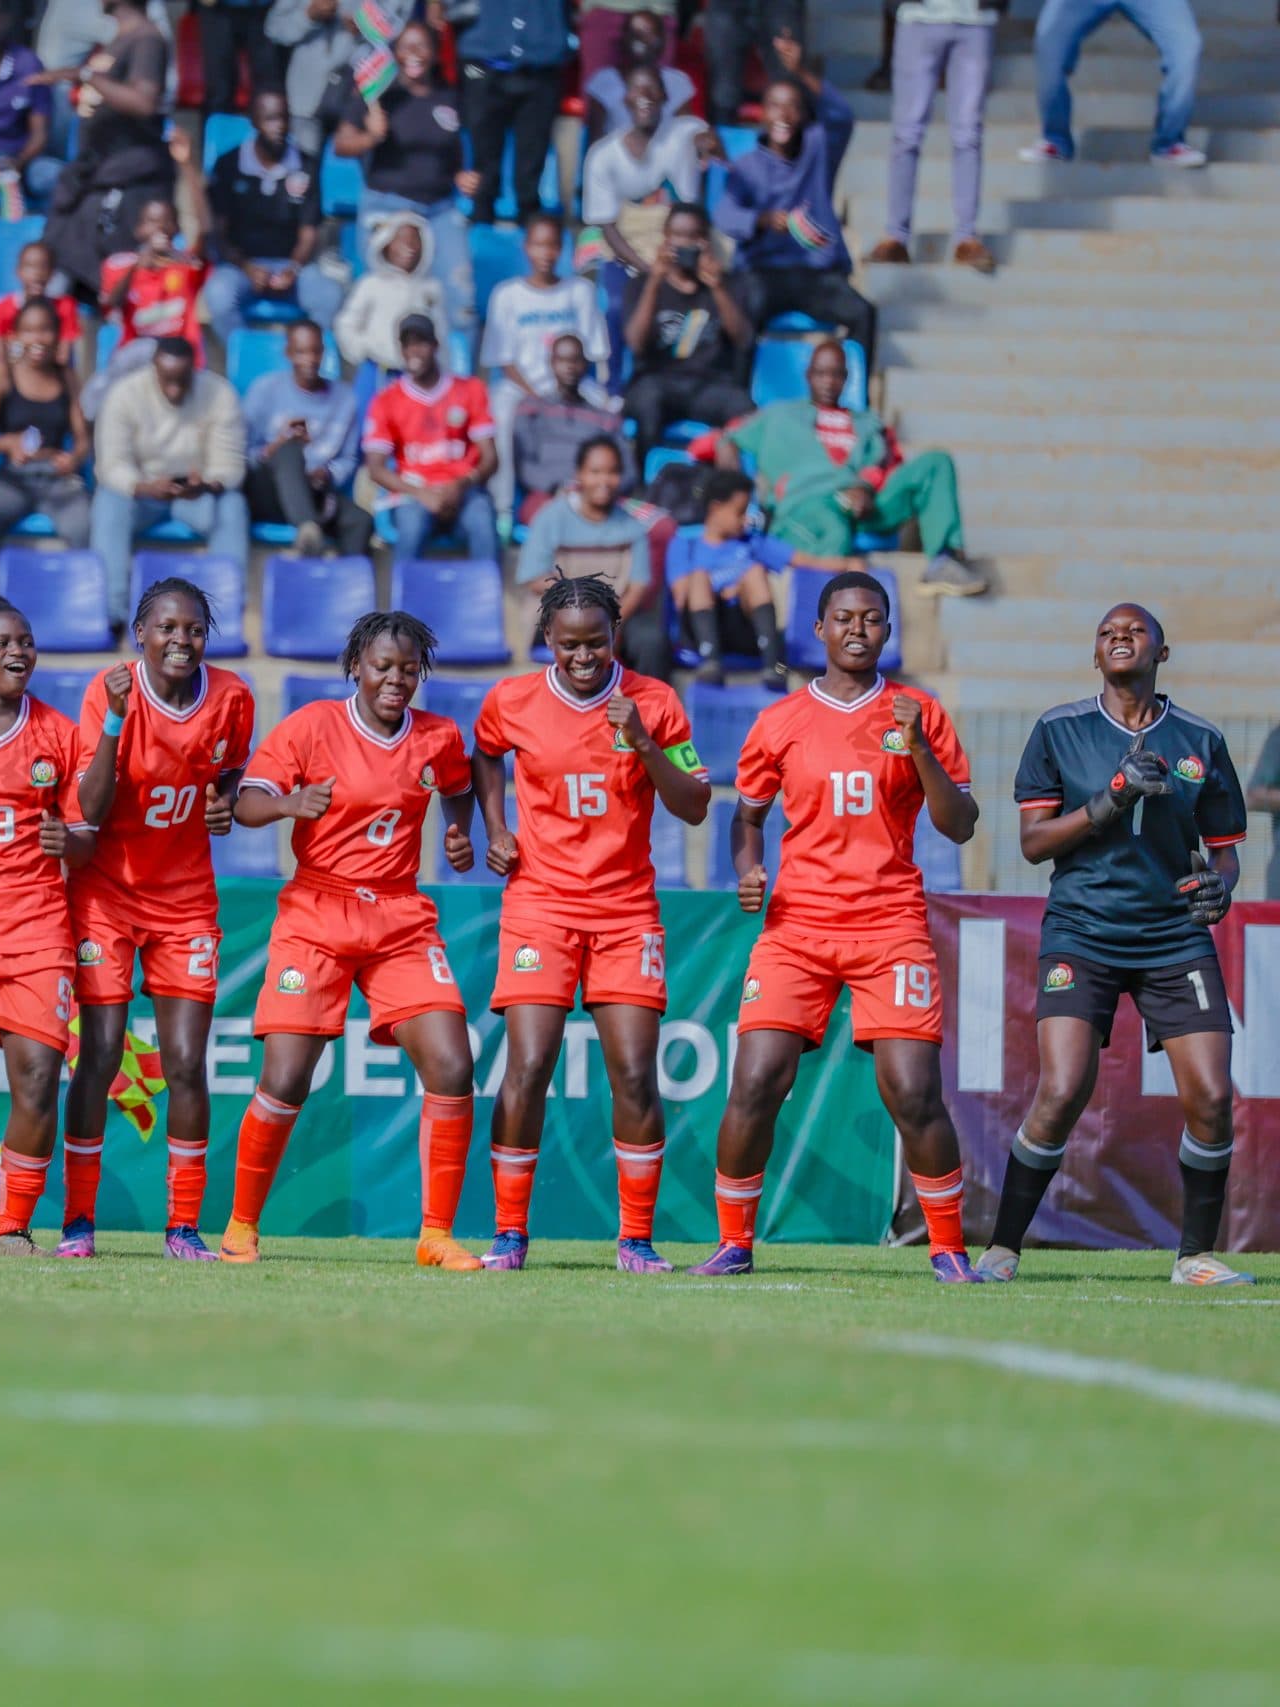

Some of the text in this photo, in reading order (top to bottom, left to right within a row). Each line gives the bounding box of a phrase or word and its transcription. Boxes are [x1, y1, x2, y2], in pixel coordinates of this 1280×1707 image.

[680, 745, 698, 768] C
[144, 785, 197, 829] 20
[564, 774, 608, 818] 15
[830, 771, 873, 816] 19
[366, 809, 402, 846] 8
[188, 935, 217, 979] 2
[427, 946, 454, 984] 8
[640, 932, 665, 980] 15
[892, 964, 930, 1008] 19
[1187, 970, 1210, 1010] 1
